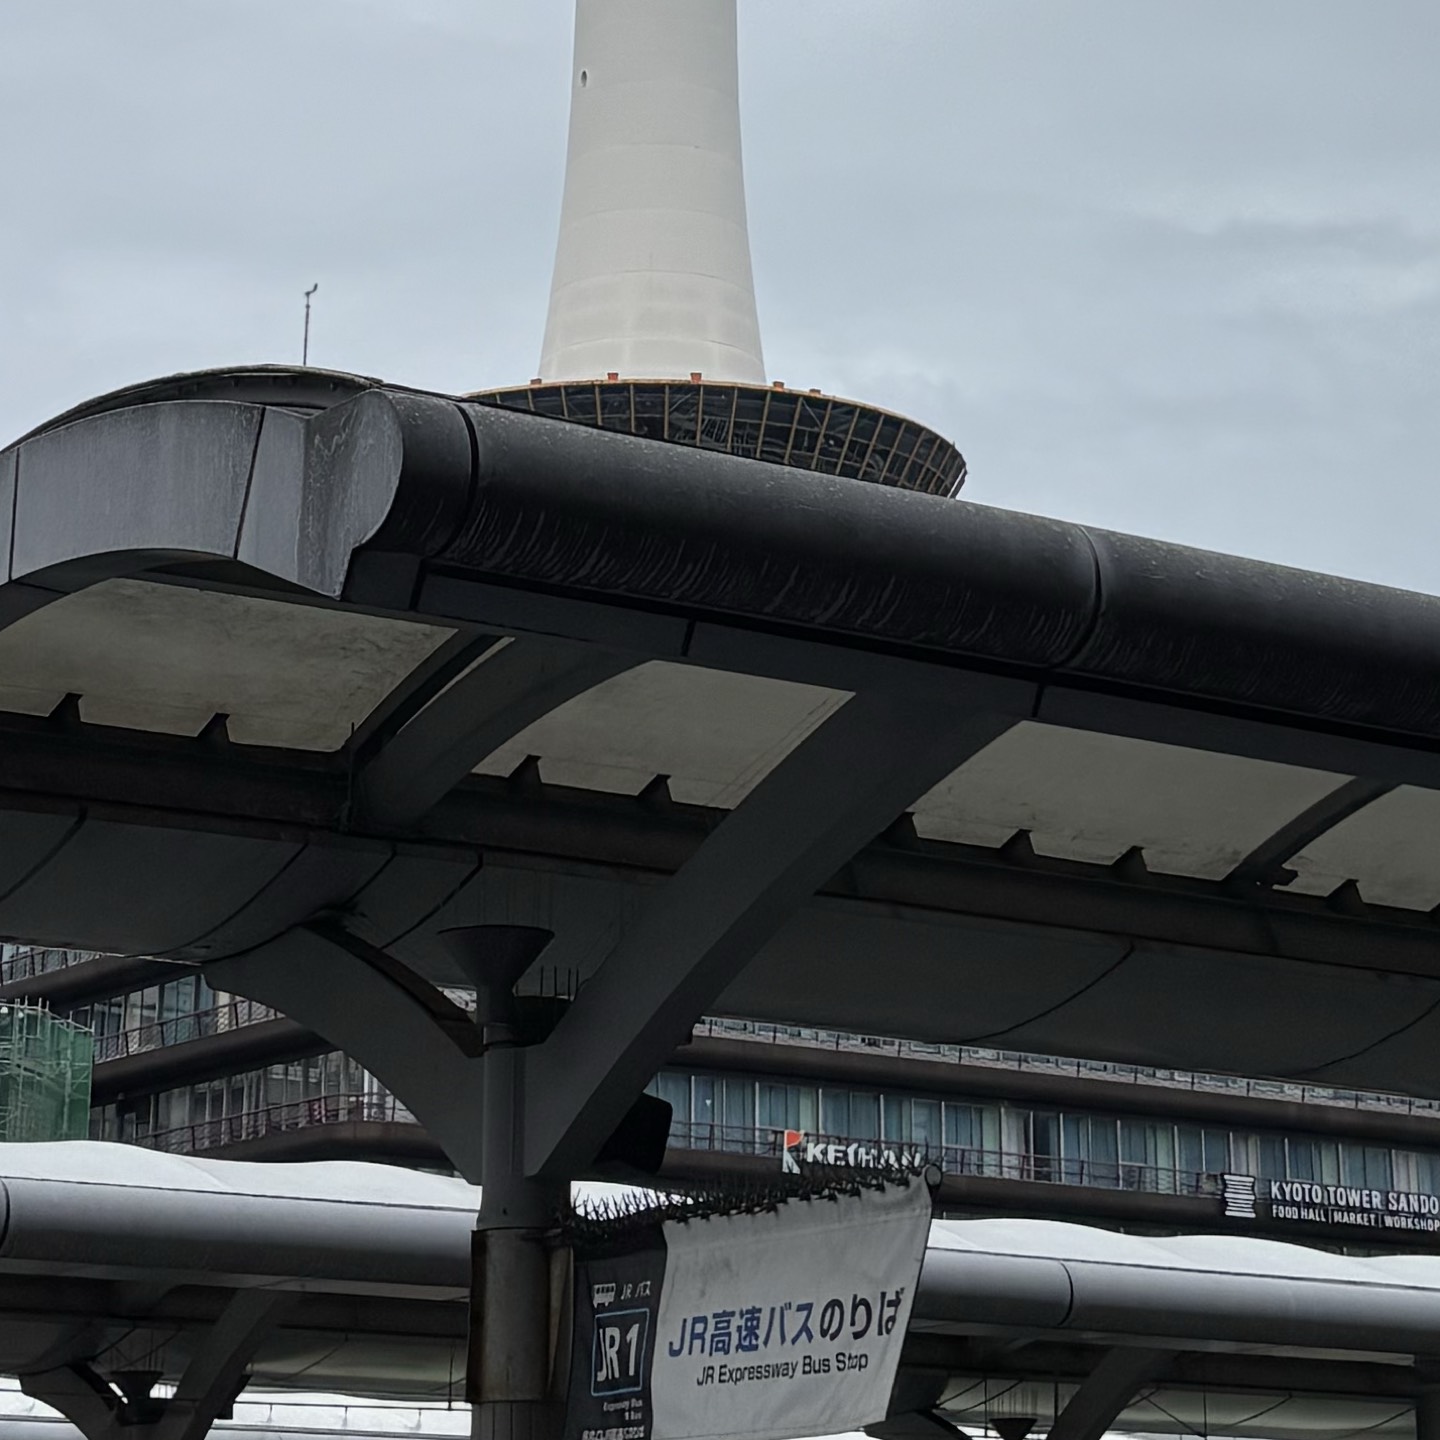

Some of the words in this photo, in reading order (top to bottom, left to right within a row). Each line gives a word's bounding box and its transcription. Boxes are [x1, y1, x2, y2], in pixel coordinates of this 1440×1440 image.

[1270, 1180, 1323, 1205] KYOTO
[1326, 1186, 1382, 1210] TOWER
[1388, 1192, 1440, 1215] SANDO
[1271, 1204, 1298, 1219] FOOD
[1300, 1207, 1327, 1222] HALL
[1333, 1210, 1376, 1227] MARKET
[1383, 1214, 1440, 1232] WORKSHOP
[668, 1286, 906, 1358] JR高速バスのりば
[697, 1366, 715, 1386] JR
[718, 1360, 798, 1384] Expressway
[802, 1355, 831, 1374] Bus
[835, 1351, 869, 1371] Stop
